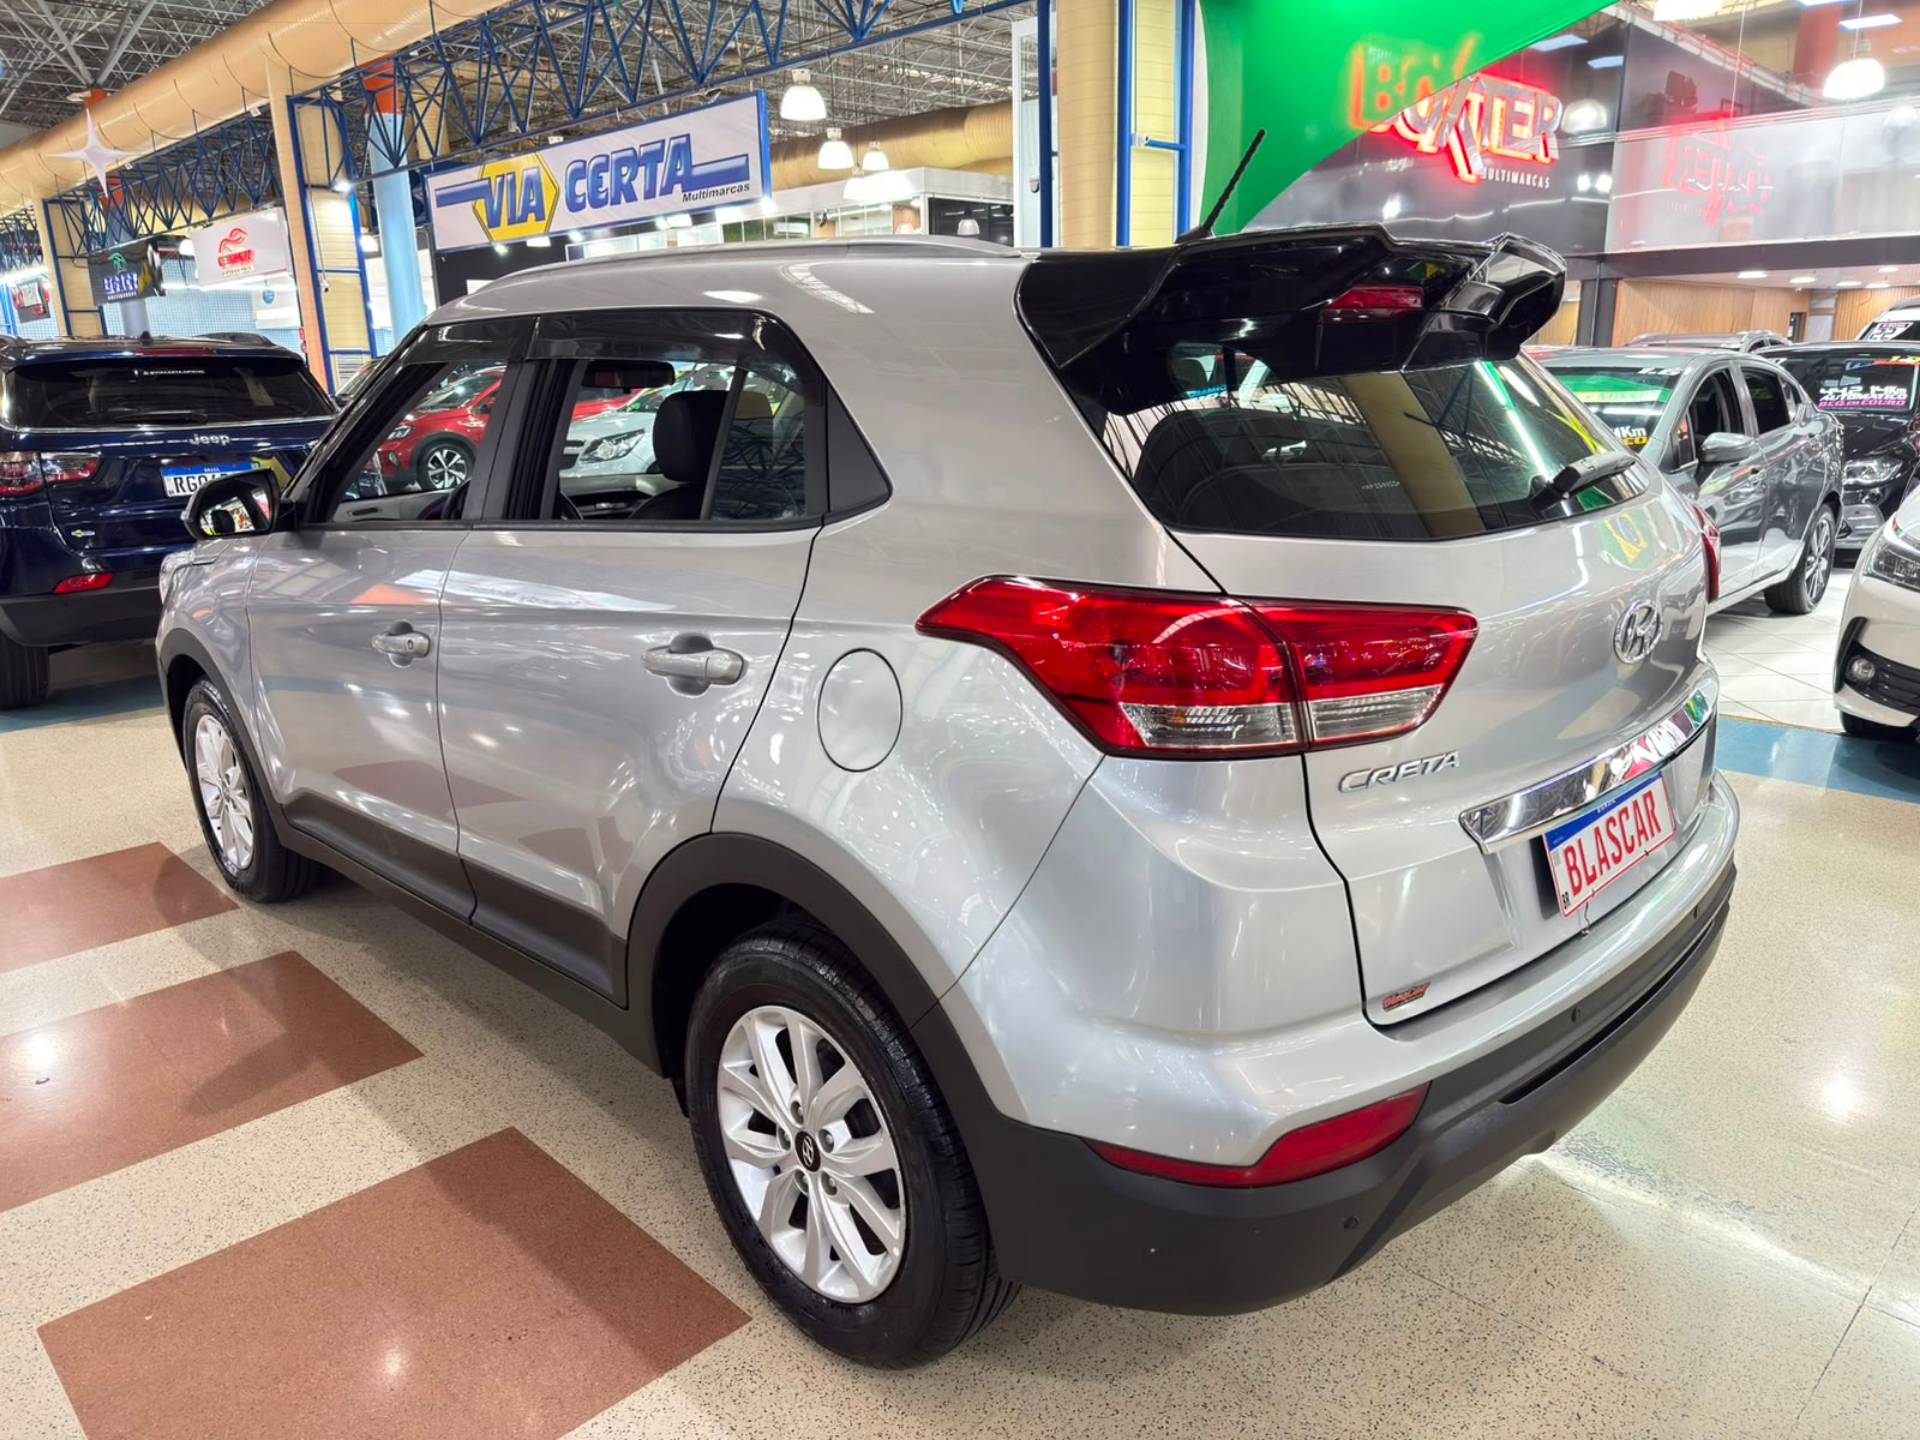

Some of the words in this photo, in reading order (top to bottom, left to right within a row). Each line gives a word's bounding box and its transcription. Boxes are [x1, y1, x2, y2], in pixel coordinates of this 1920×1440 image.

[484, 167, 547, 229] VIA
[564, 133, 693, 214] CERTA
[682, 183, 750, 203] Multimarcas
[189, 433, 231, 446] Jeep
[1338, 750, 1460, 793] CRETA
[1562, 790, 1662, 897] BLASCAR
